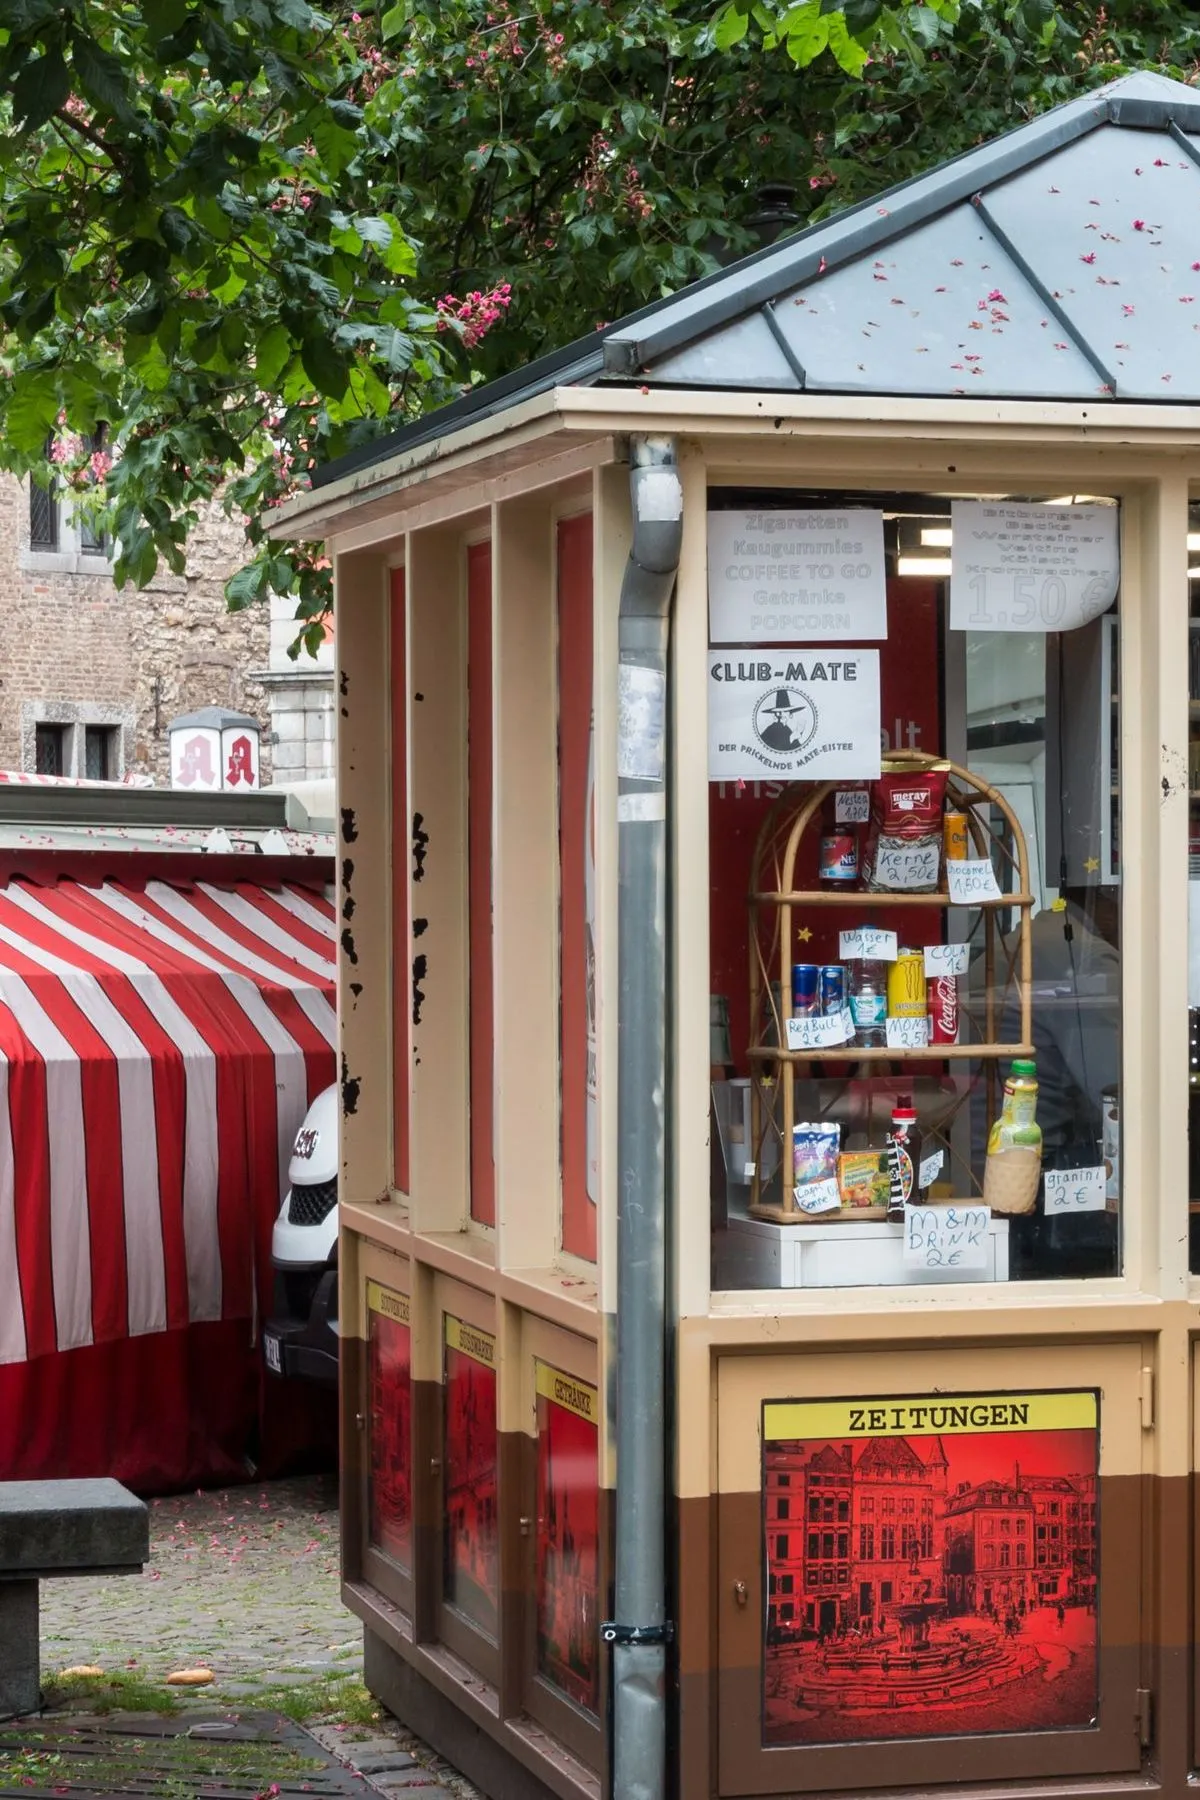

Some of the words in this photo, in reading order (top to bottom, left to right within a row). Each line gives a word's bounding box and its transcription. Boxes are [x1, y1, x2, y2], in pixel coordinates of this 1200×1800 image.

[745, 512, 849, 533] Zigaretten
[733, 538, 863, 558] Kaugummies
[725, 563, 801, 581] COFFEE
[806, 563, 834, 580] TO
[840, 563, 872, 580] GO
[753, 588, 846, 606] Getränke
[968, 574, 1067, 625] 1.50
[1080, 576, 1110, 622] €
[750, 613, 851, 631] POPCORN
[710, 661, 858, 683] CLUB-MATE
[718, 743, 736, 753] DER
[740, 744, 793, 771] PRICKELNDE
[892, 790, 929, 804] meray
[880, 850, 936, 866] Kerne
[842, 931, 893, 944] Wasser
[931, 944, 967, 960] COLA
[1047, 1170, 1100, 1190] granini
[849, 1404, 1029, 1431] ZEITUNGEN
